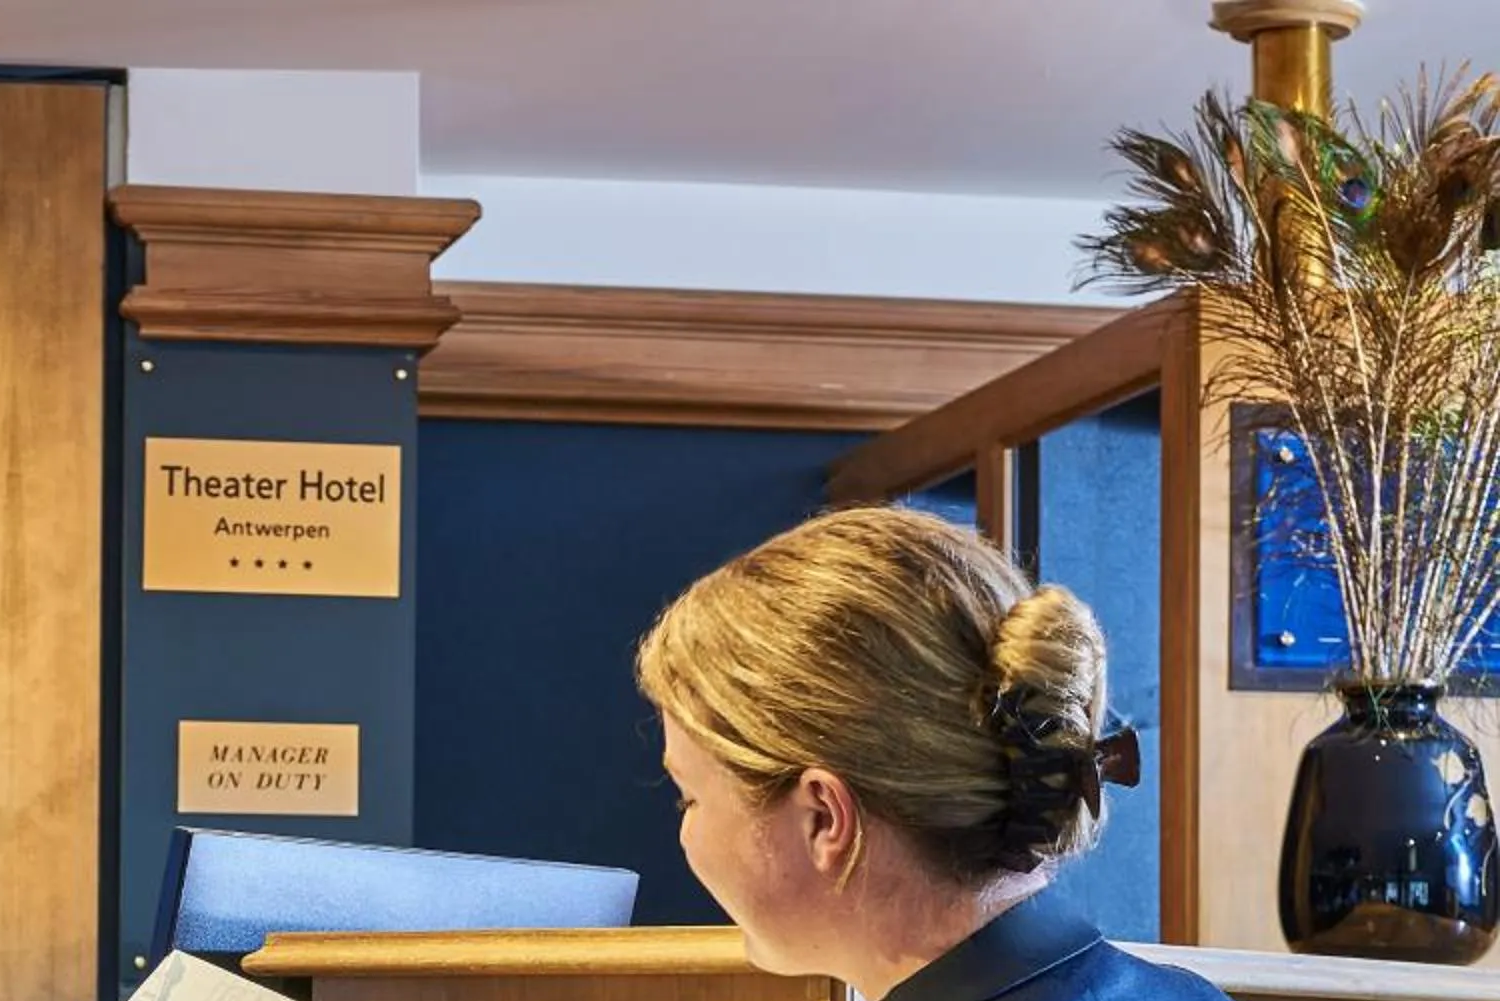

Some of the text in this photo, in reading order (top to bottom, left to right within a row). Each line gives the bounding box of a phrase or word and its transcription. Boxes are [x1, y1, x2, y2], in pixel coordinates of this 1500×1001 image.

[160, 464, 385, 503] Theater Hotel
[213, 516, 330, 541] Antwerpen
[209, 744, 330, 766] MANAGER
[206, 770, 328, 792] ON DUTY
